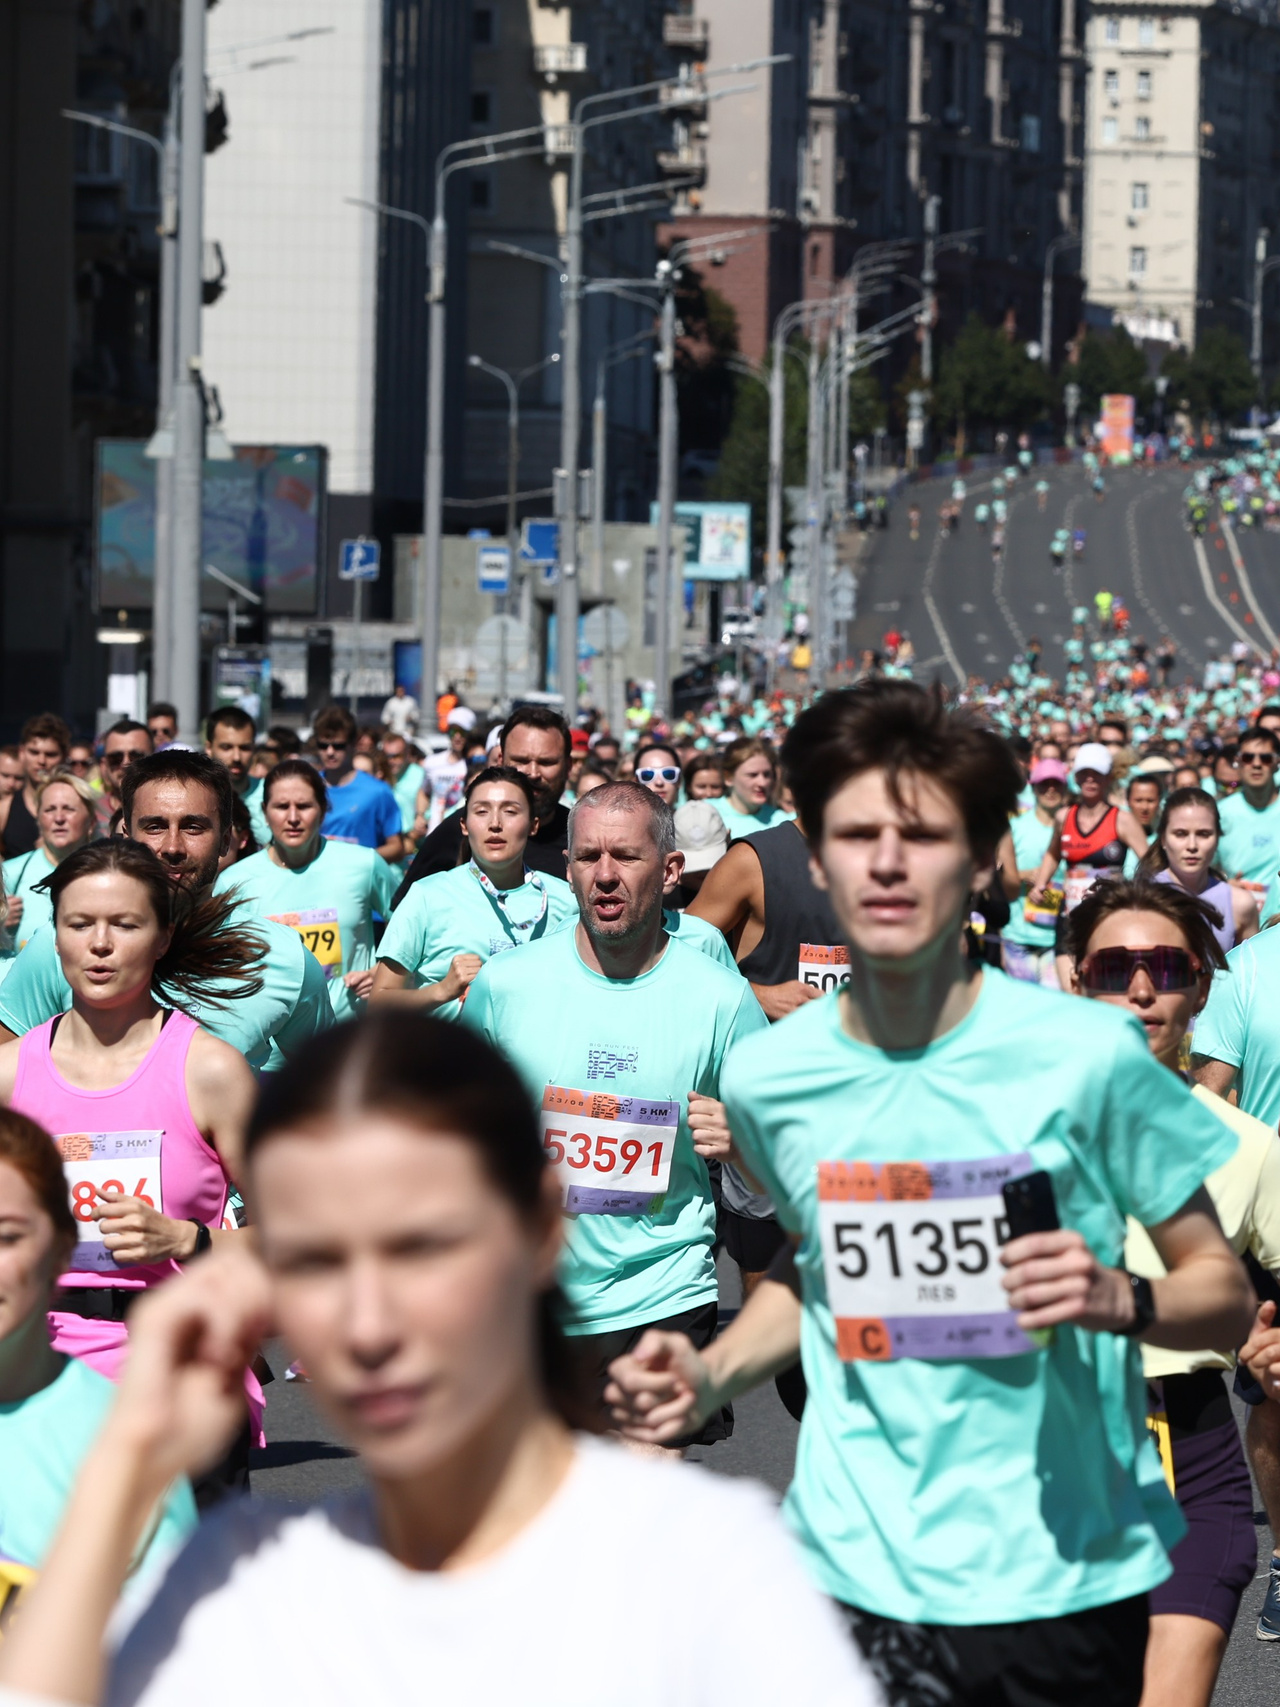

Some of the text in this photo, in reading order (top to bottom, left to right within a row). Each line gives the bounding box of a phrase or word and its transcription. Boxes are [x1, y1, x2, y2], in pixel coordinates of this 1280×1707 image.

[549, 1096, 584, 1106] 23/08
[639, 1107, 647, 1115] 5
[115, 1140, 123, 1148] 5
[543, 1128, 663, 1176] 53591
